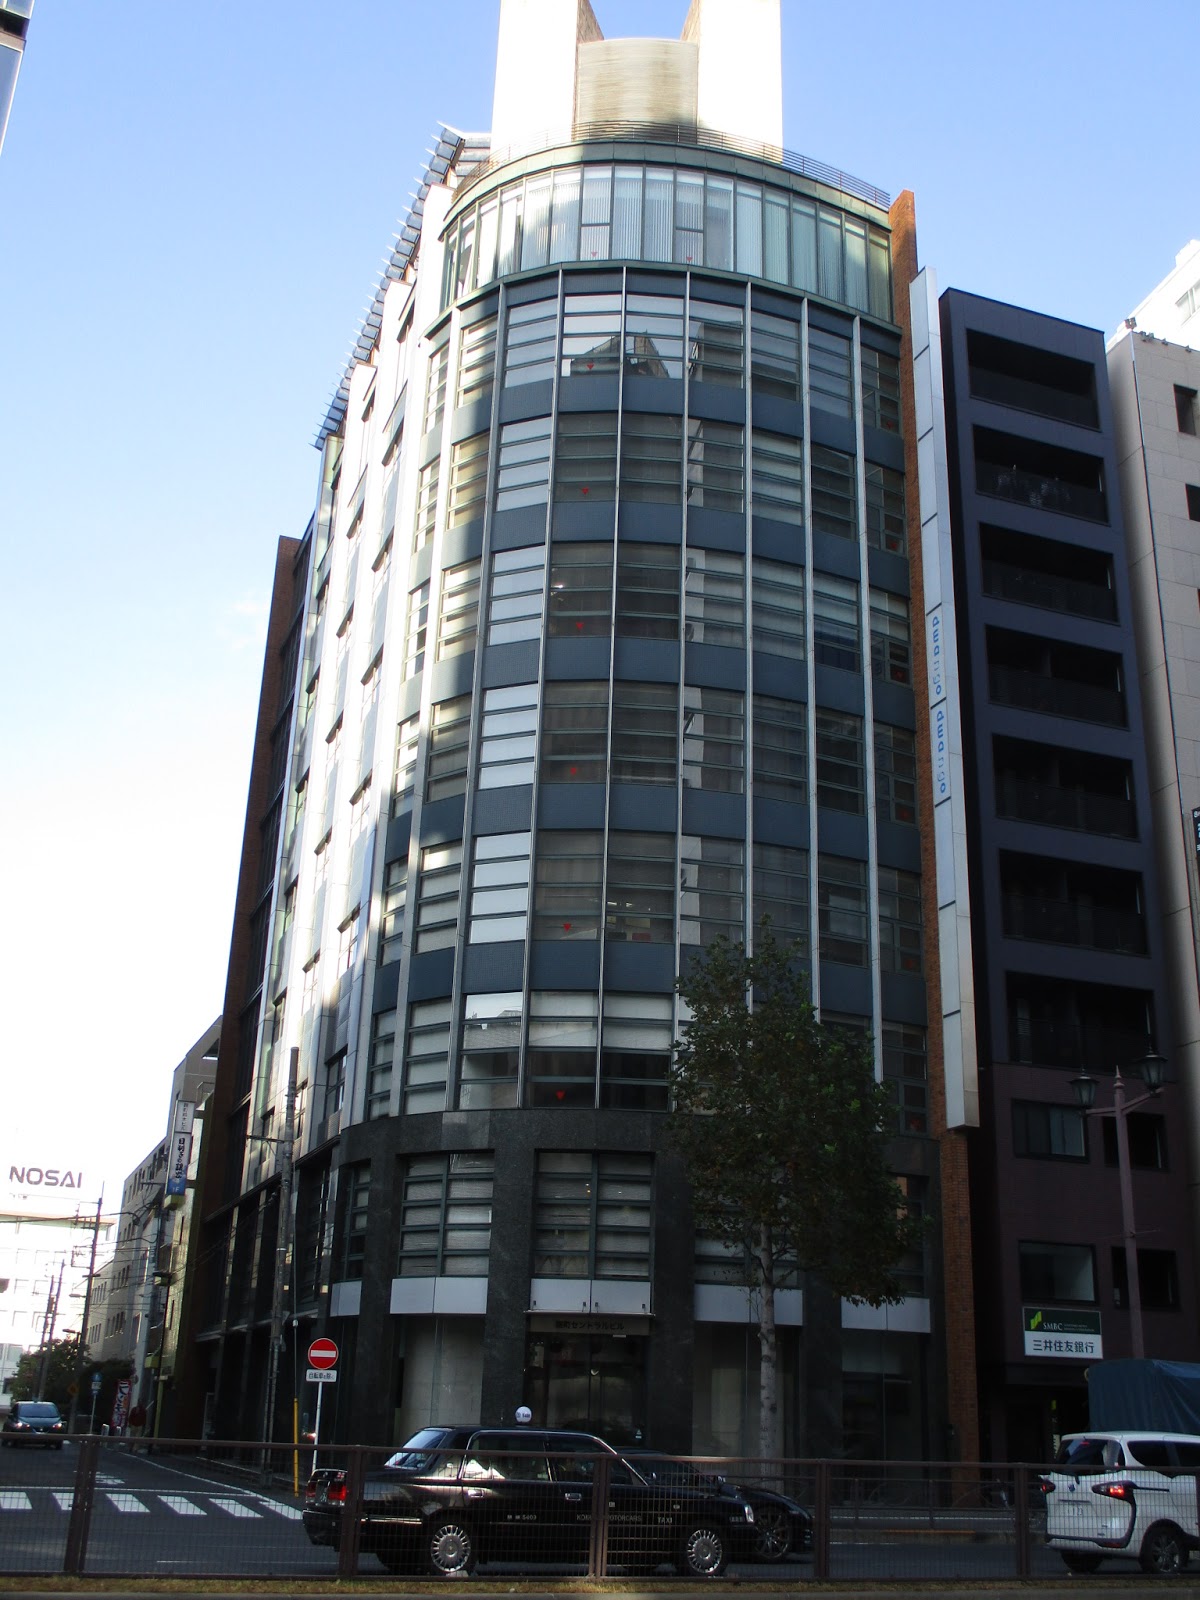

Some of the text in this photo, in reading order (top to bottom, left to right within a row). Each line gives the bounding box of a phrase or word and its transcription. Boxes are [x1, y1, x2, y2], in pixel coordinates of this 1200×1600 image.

[932, 616, 943, 696] dwango
[936, 710, 947, 794] dwango
[9, 1165, 82, 1188] NOSAI
[1043, 1322, 1063, 1331] SMBC
[1033, 1339, 1095, 1354] 三井住友銀行
[657, 1516, 673, 1524] TAXI
